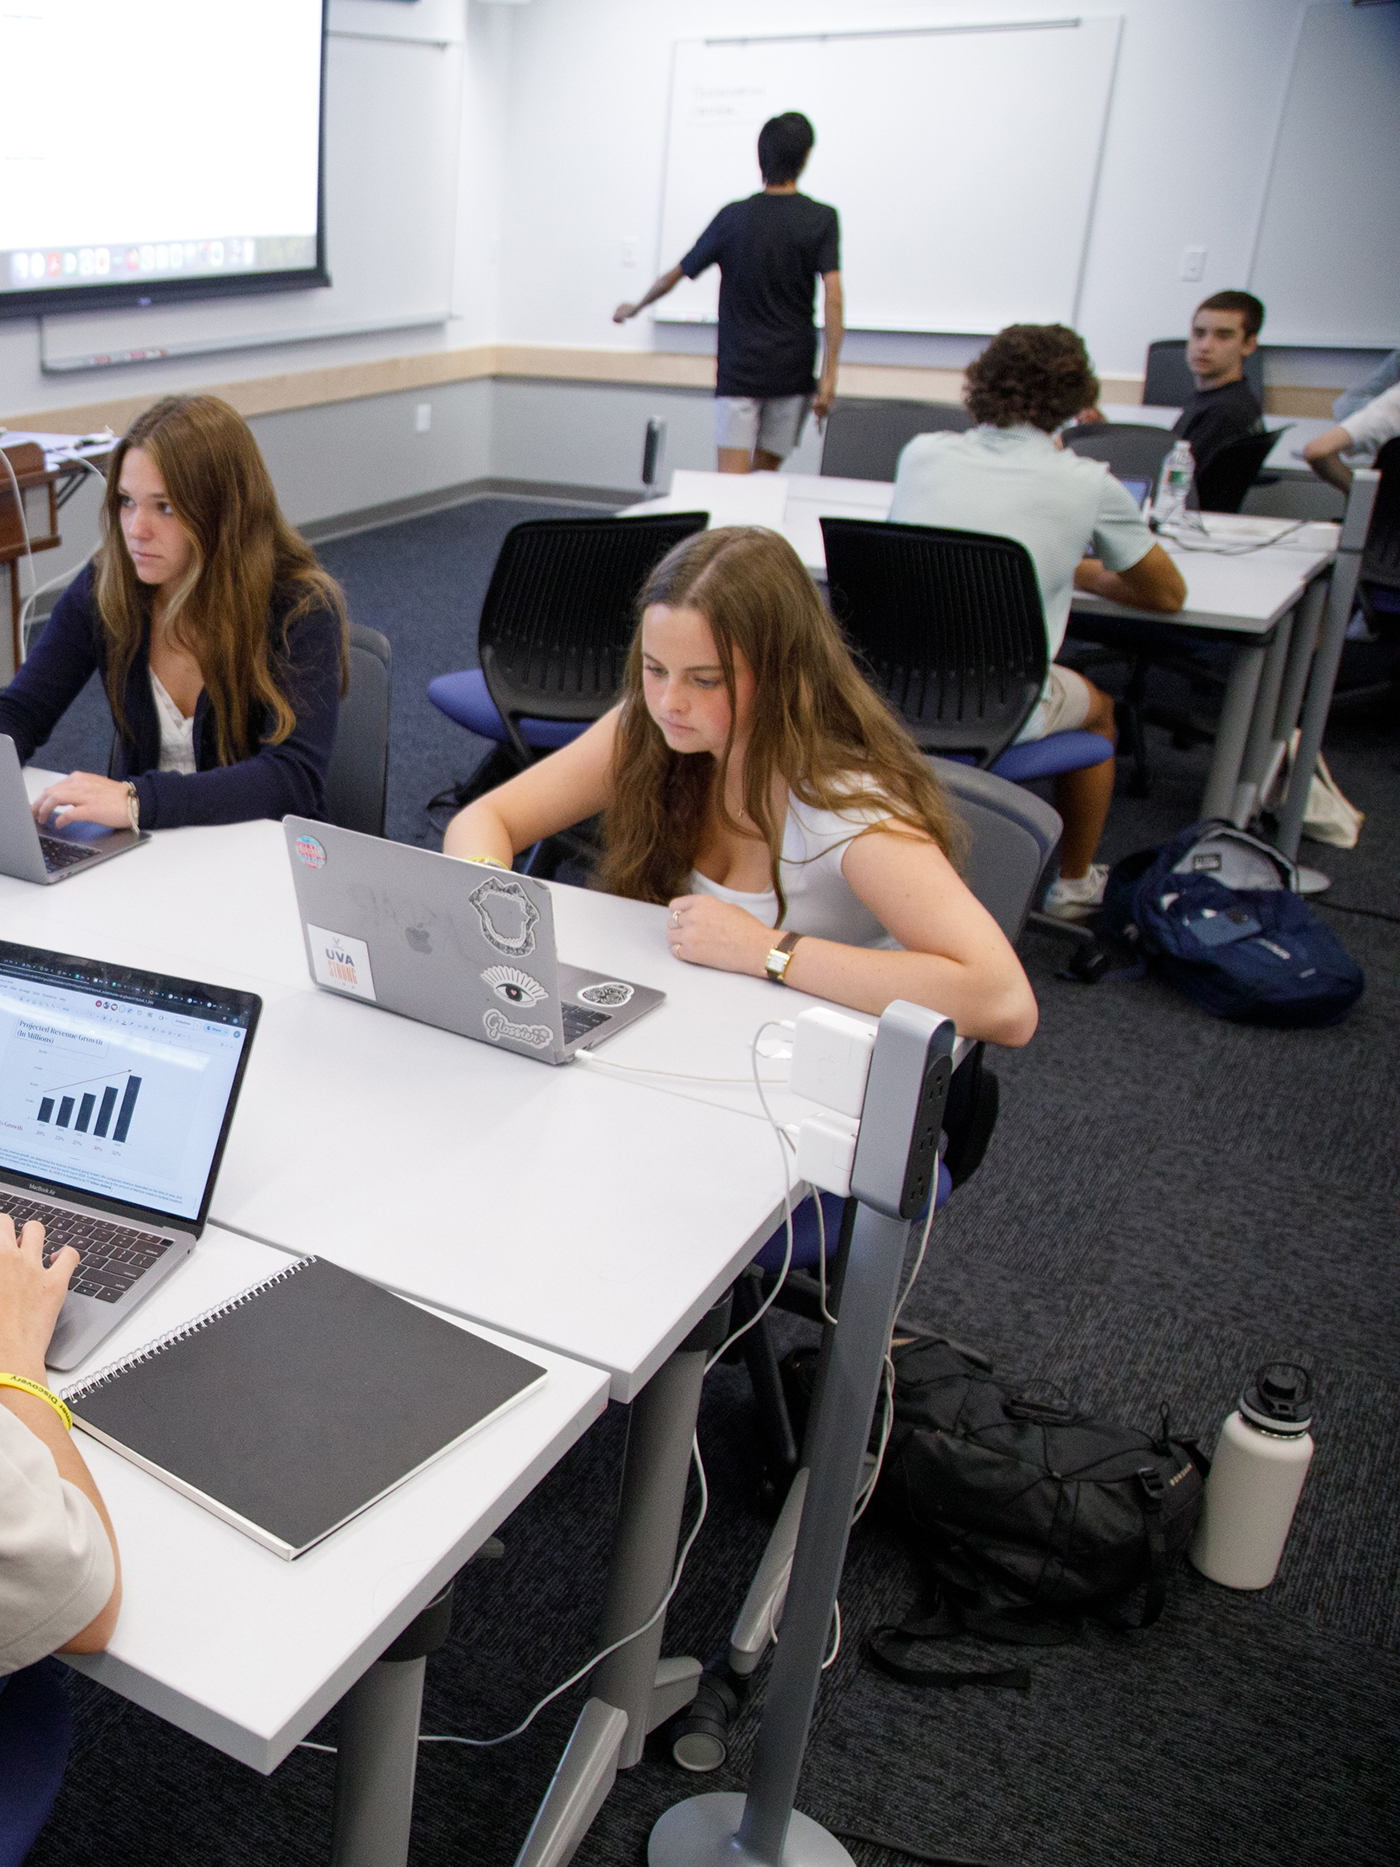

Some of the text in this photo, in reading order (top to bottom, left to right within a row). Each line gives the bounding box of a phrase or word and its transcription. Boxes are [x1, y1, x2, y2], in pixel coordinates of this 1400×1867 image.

[325, 948, 355, 967] UVA
[328, 960, 358, 984] STRONG
[19, 1020, 103, 1046] Projected Revenue Growth
[486, 1012, 542, 1043] Glossier
[27, 1032, 55, 1044] Millions)
[4, 1122, 23, 1131] Growth
[28, 1183, 49, 1194] MacBook
